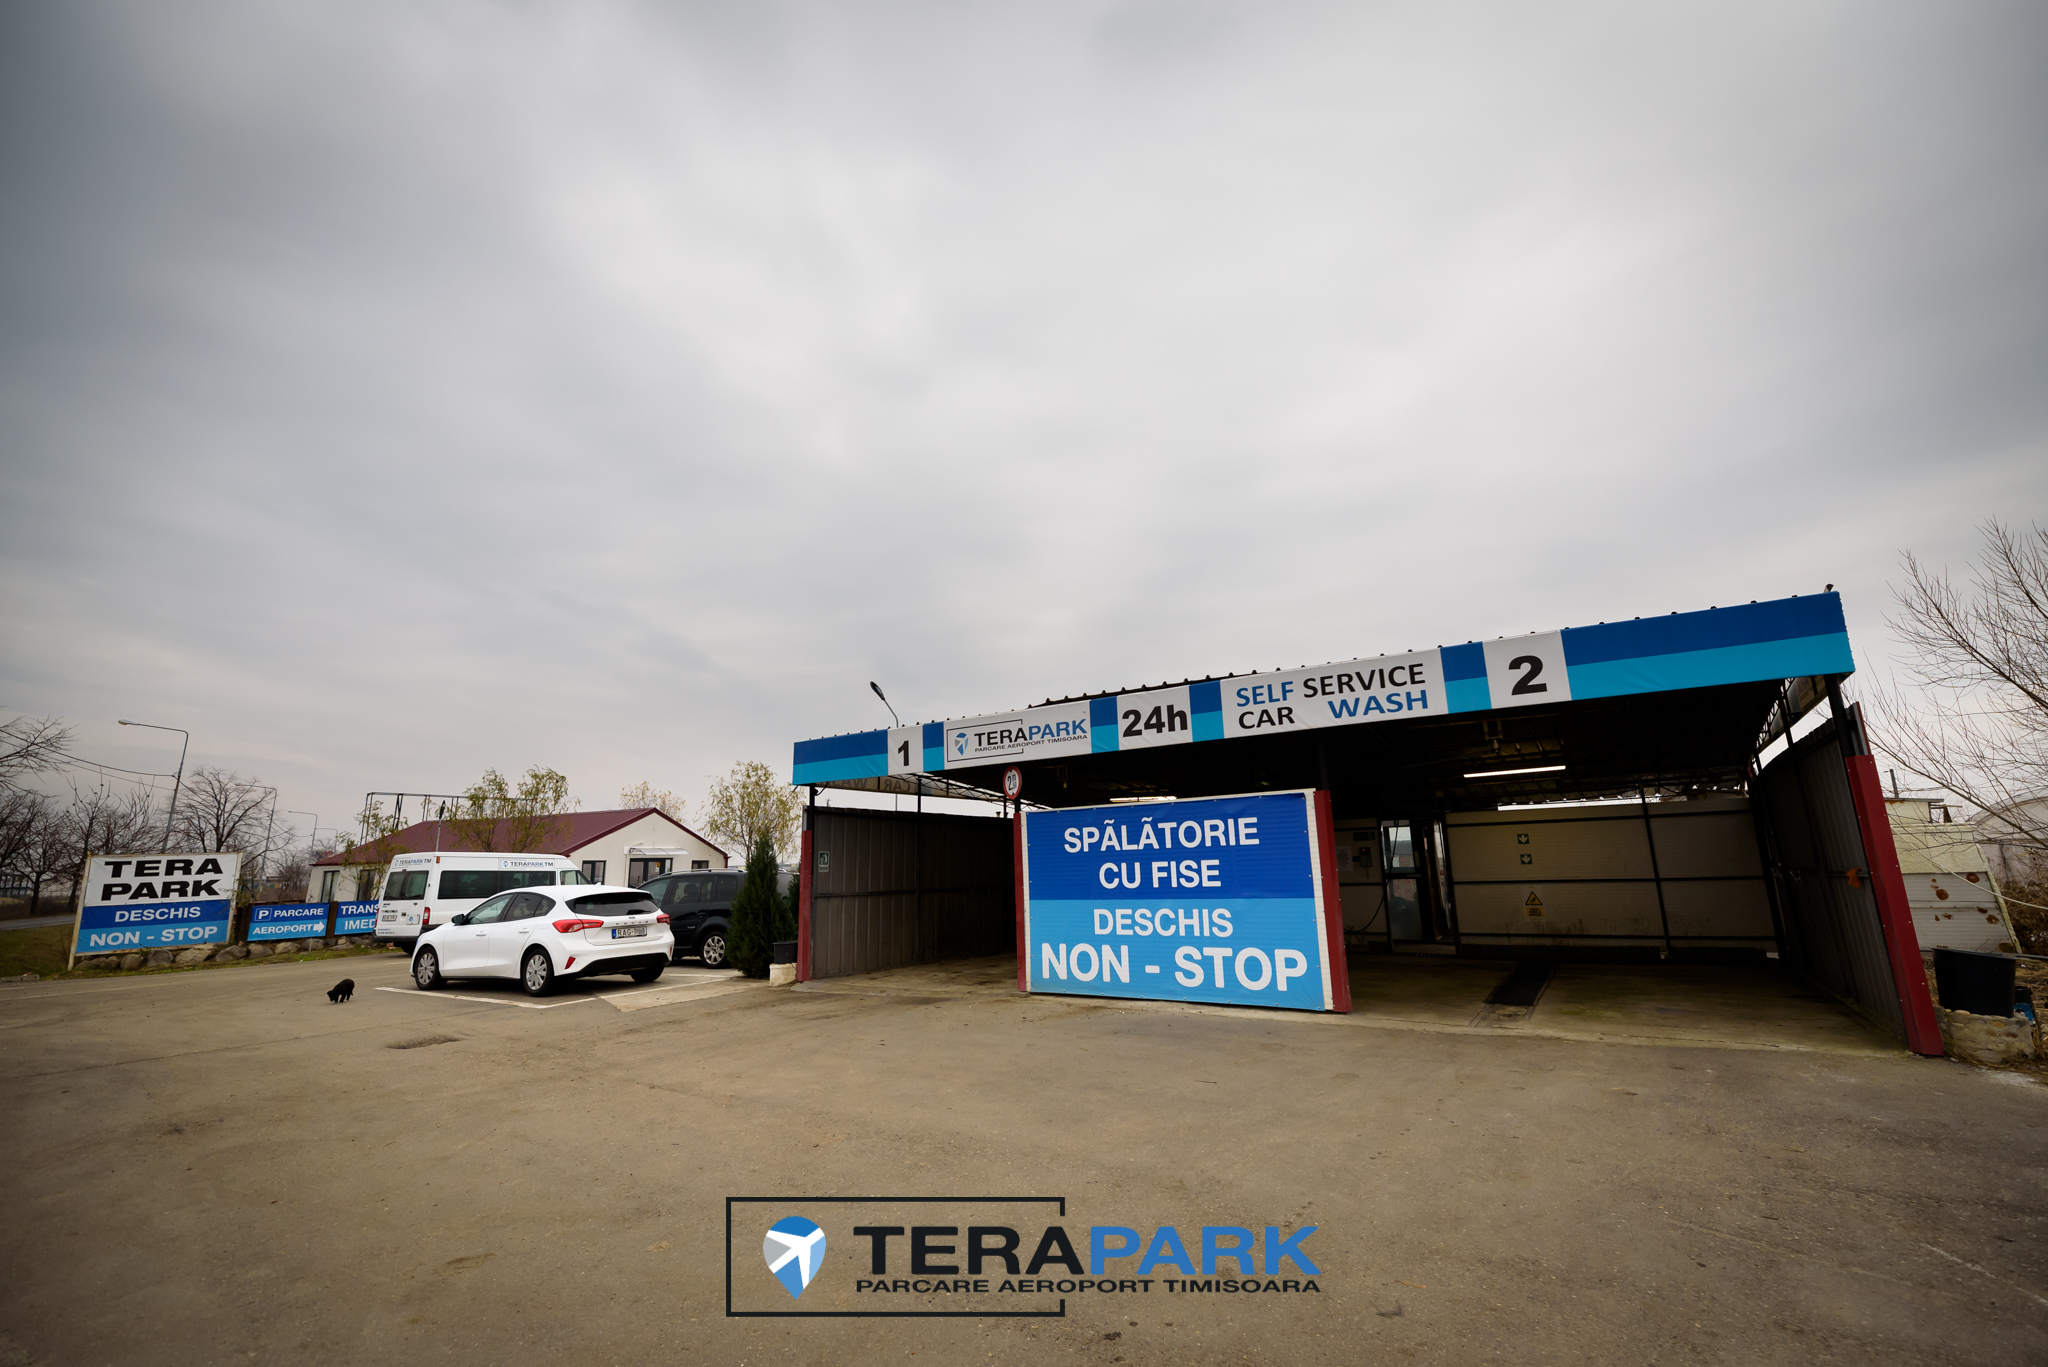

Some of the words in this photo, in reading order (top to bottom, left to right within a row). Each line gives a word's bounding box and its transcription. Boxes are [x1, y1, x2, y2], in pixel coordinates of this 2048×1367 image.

[1235, 680, 1294, 707] SELF
[1302, 663, 1426, 698] SERVICE
[1508, 654, 1548, 696] 2
[1122, 703, 1189, 738] 24h
[1238, 706, 1296, 730] CAR
[1327, 689, 1429, 719] WASH
[974, 719, 1088, 747] TERAPARK
[974, 744, 1006, 753] PARCARE
[1007, 740, 1045, 749] AEROPORT
[1047, 734, 1088, 744] TIMISOARA
[897, 740, 911, 766] 1
[104, 858, 223, 878] TERA
[1099, 862, 1141, 889] CU
[1151, 859, 1221, 888] FISE
[101, 879, 222, 901] PARK
[114, 906, 201, 922] DESCHIS
[258, 910, 269, 920] P
[274, 908, 324, 918] PARCARE
[1093, 908, 1234, 938] DESCHIS
[89, 931, 140, 947] NON
[160, 926, 218, 942] STOP
[252, 924, 313, 935] AEROPORT
[1041, 943, 1131, 983] NON
[1144, 965, 1161, 974] -
[1174, 946, 1308, 992] STOP
